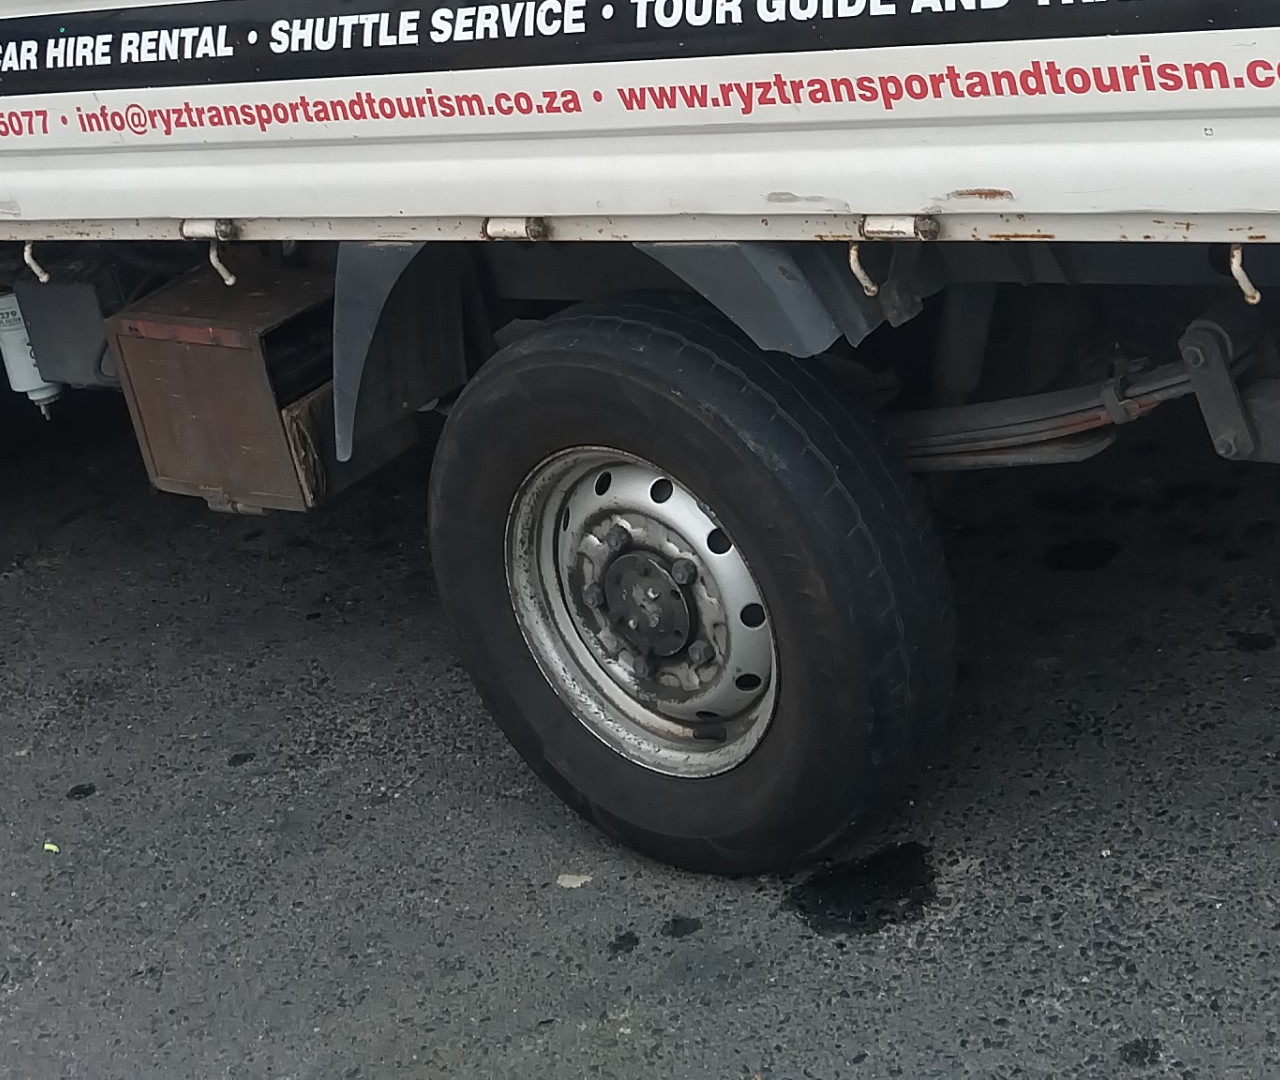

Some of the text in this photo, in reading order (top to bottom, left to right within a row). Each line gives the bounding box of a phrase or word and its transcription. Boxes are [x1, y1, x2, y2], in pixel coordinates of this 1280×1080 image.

[46, 33, 112, 69] HIRE
[120, 25, 234, 65] RENTAL
[269, 11, 420, 55] SHUTTLE
[76, 87, 582, 137] info@ryztransportandtourism.co.za
